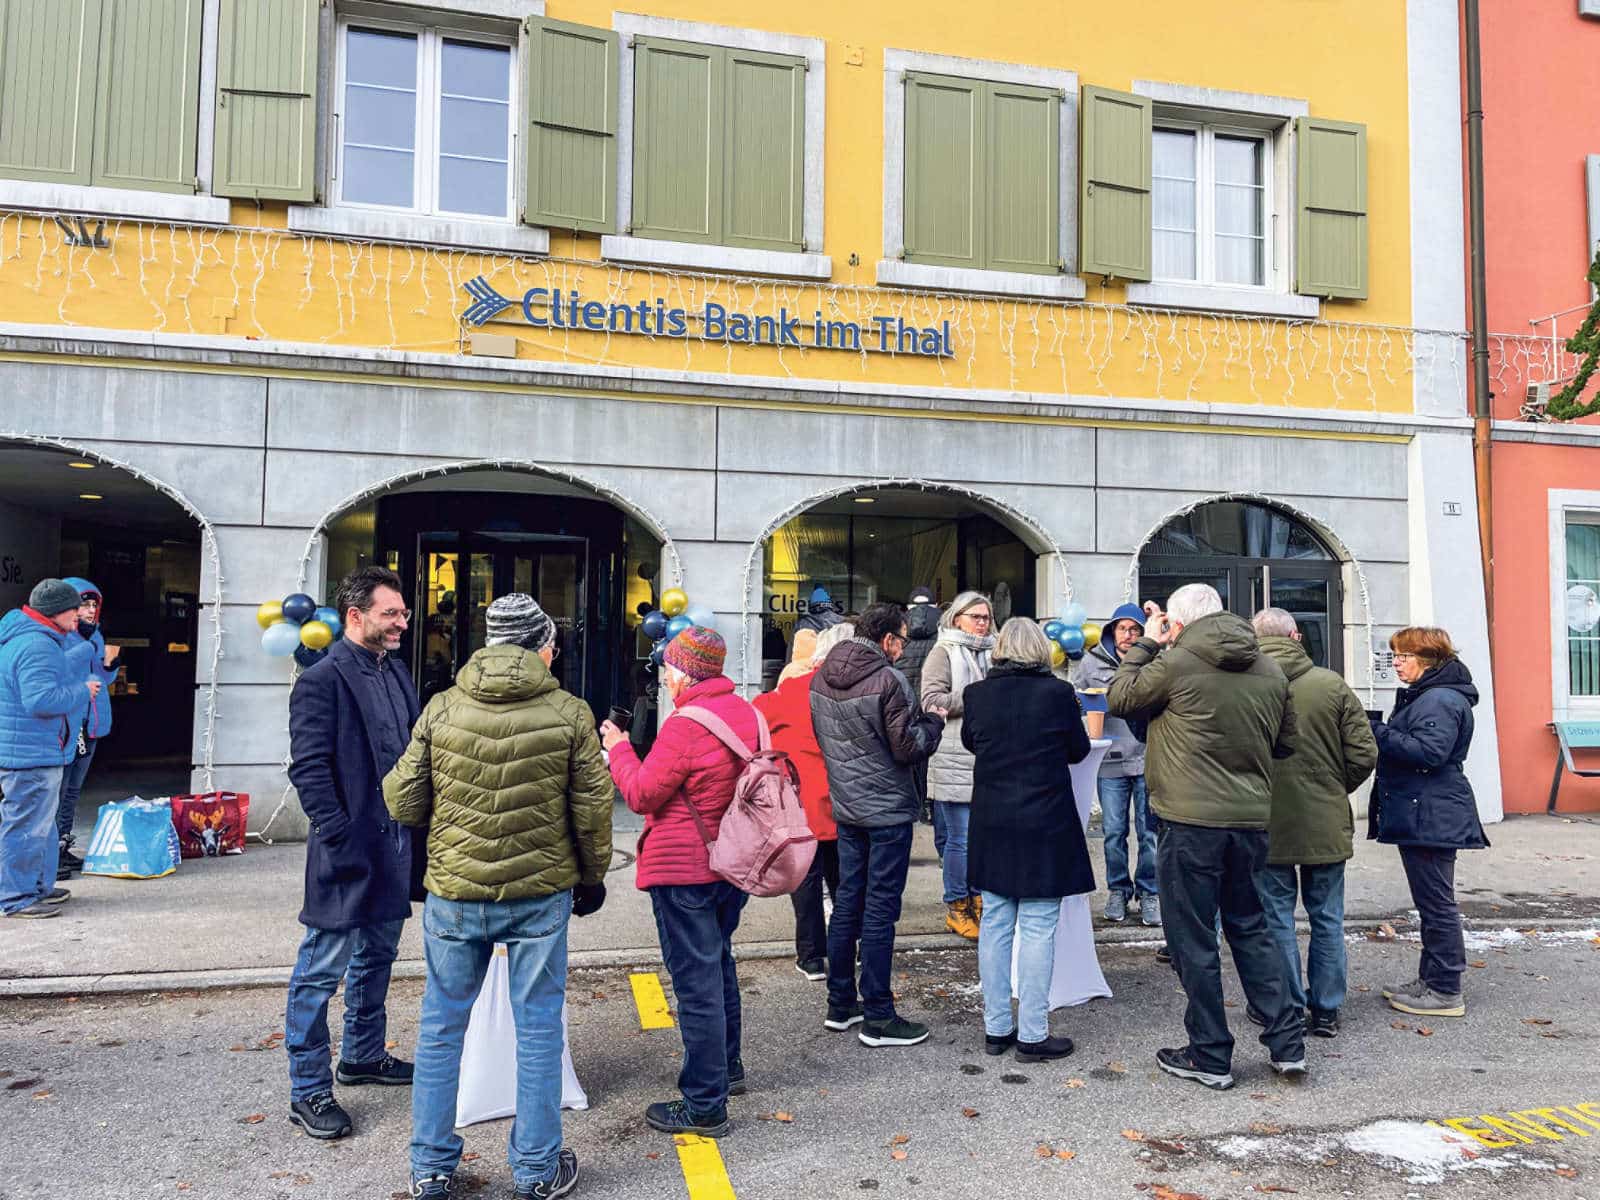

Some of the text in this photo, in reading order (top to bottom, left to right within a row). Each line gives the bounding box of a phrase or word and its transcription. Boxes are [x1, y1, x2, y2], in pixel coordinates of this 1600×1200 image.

[522, 286, 955, 356] Clientis Bank im Thal
[768, 594, 845, 614] Clies
[768, 618, 793, 633] Ban
